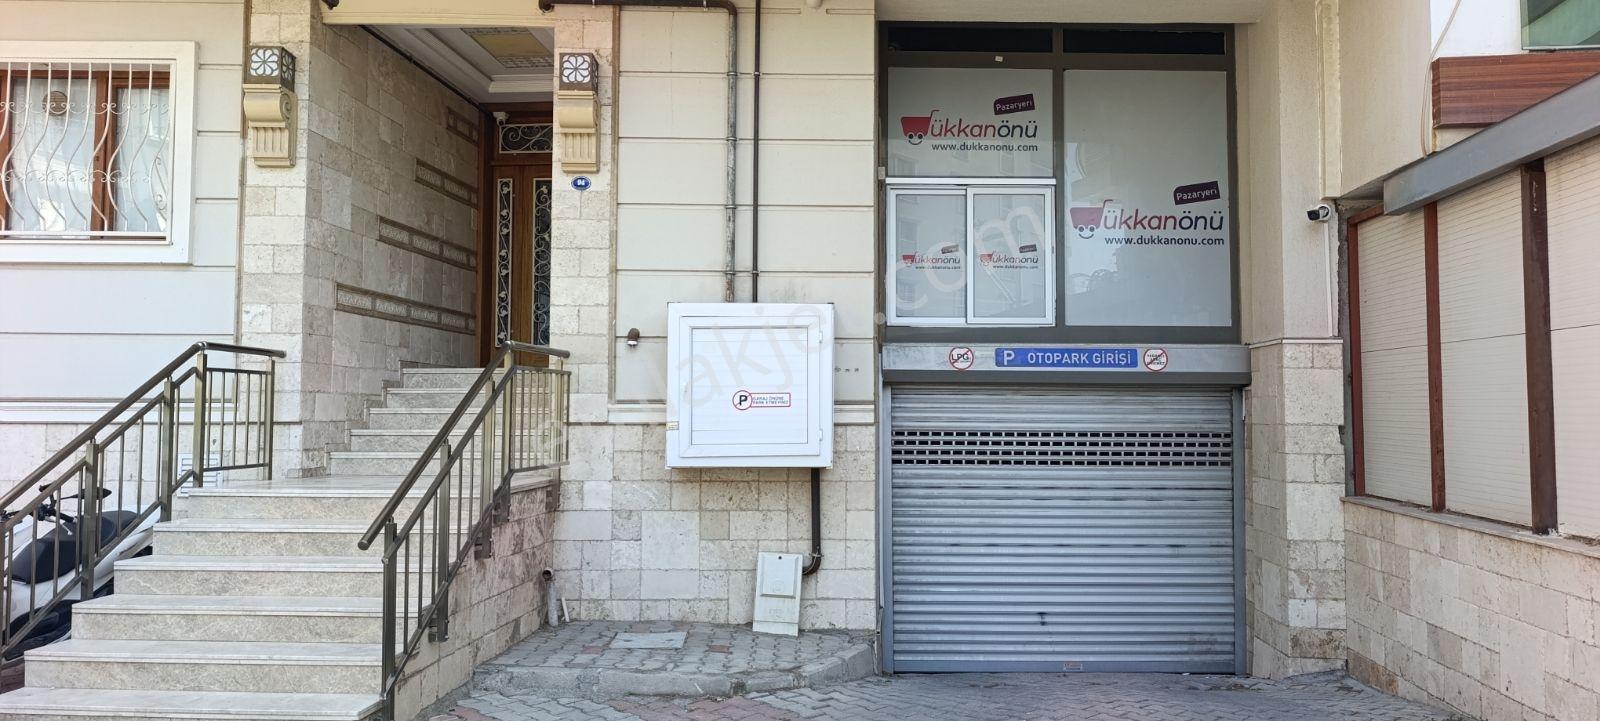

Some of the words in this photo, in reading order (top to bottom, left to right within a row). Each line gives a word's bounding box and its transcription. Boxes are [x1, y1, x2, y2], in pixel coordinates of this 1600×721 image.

[995, 100, 1033, 111] Pazaryeri
[931, 142, 1038, 152] www.dukkanonu.com
[1176, 187, 1217, 201] Pazaryeri
[1104, 235, 1225, 245] www.dukkanonu.com
[951, 353, 969, 361] LPG
[1003, 350, 1015, 366] P
[1027, 351, 1089, 365] OTOPARK
[1093, 350, 1131, 366] GİRİŞİ
[739, 395, 748, 406] P
